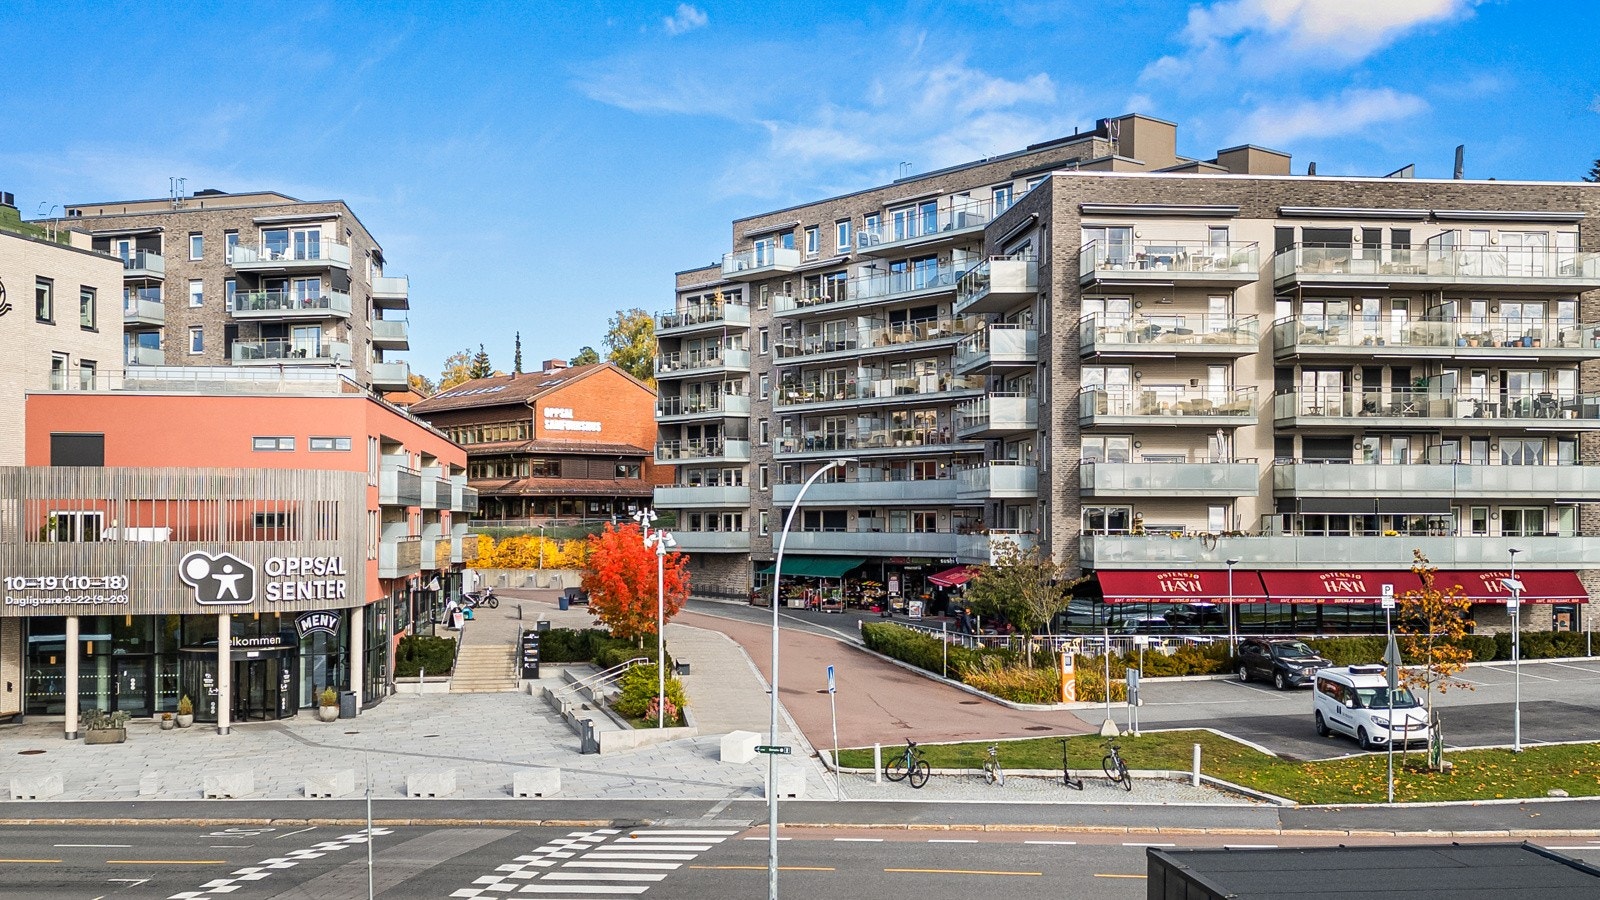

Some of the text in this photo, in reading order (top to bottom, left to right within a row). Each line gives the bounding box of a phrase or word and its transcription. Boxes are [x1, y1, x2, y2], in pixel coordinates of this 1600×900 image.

[265, 556, 347, 576] OPPSAL
[266, 579, 347, 601] SENTER
[1384, 585, 1391, 594] P
[5, 596, 61, 607] Dagligvare
[300, 614, 337, 631] MENY
[228, 636, 281, 647] elkommen
